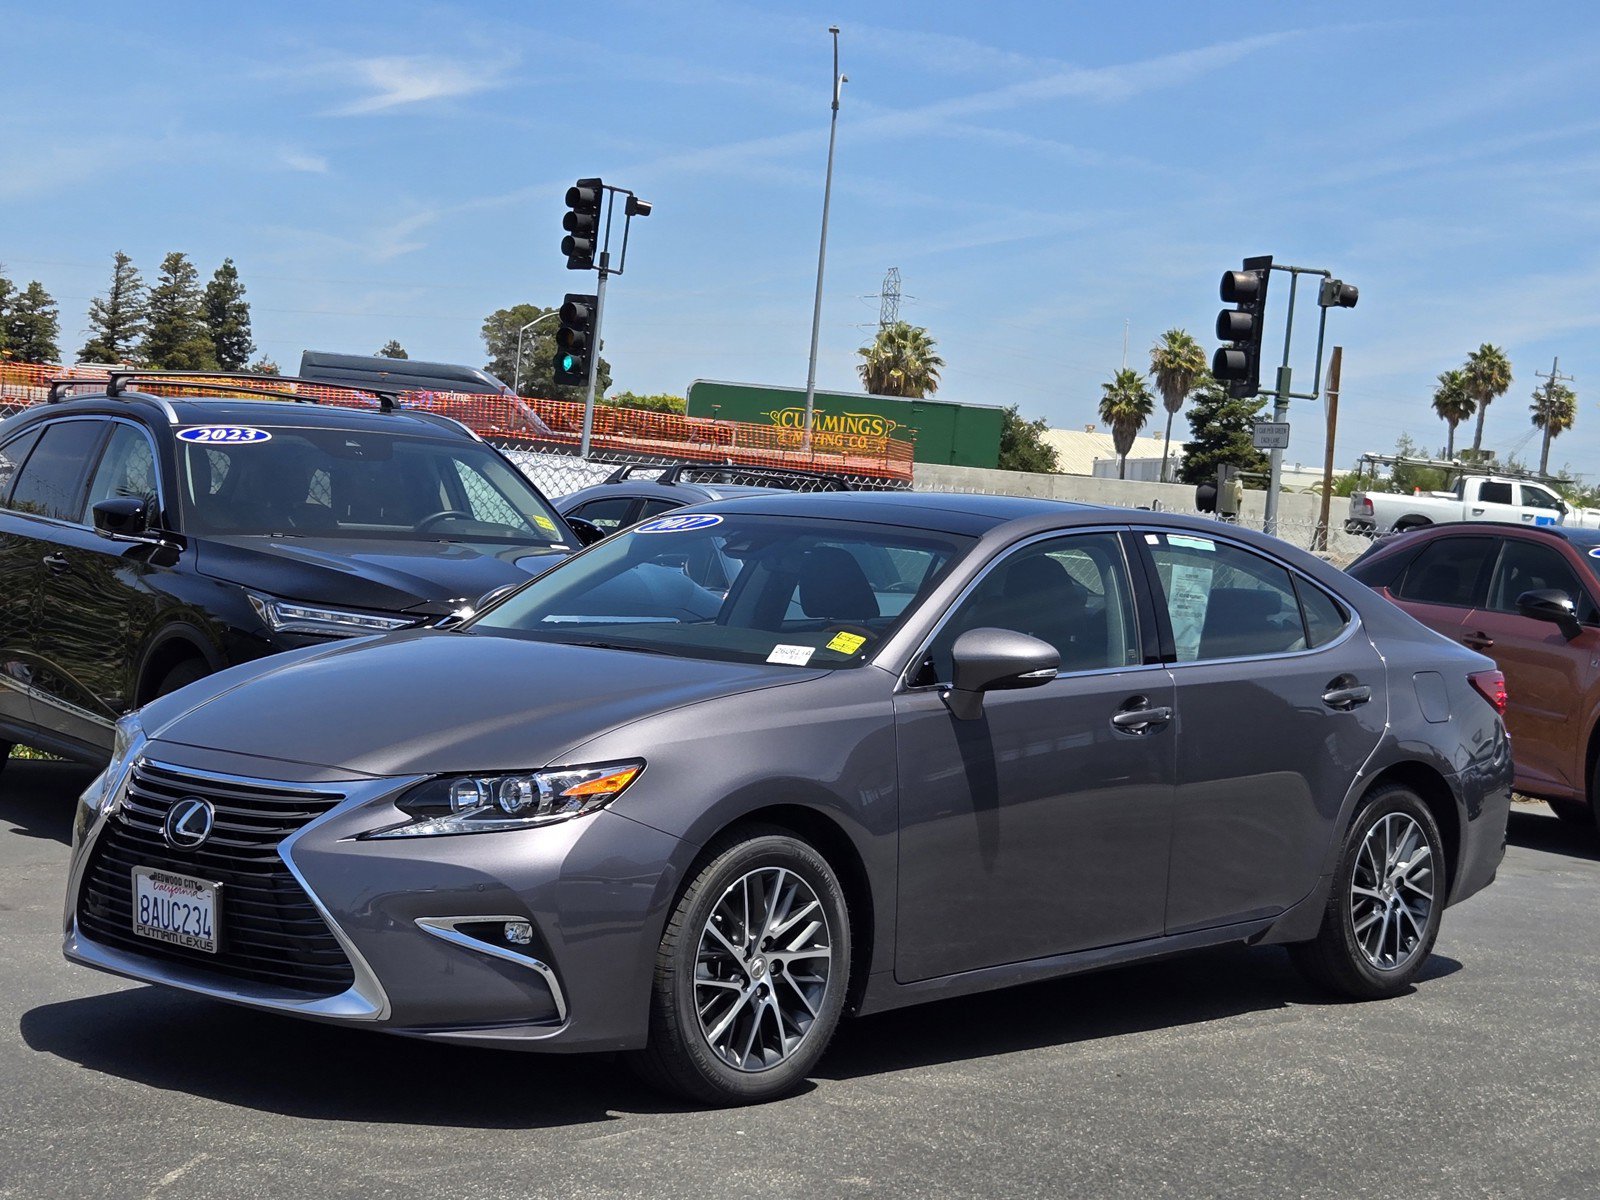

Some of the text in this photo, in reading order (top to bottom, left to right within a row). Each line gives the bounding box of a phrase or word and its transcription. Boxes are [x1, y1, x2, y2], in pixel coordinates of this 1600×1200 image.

[195, 429, 257, 441] 2023
[153, 872, 199, 889] REDWOOD CITY
[140, 894, 212, 939] 8AUC234
[136, 924, 214, 951] PUTNAM LEXUS
